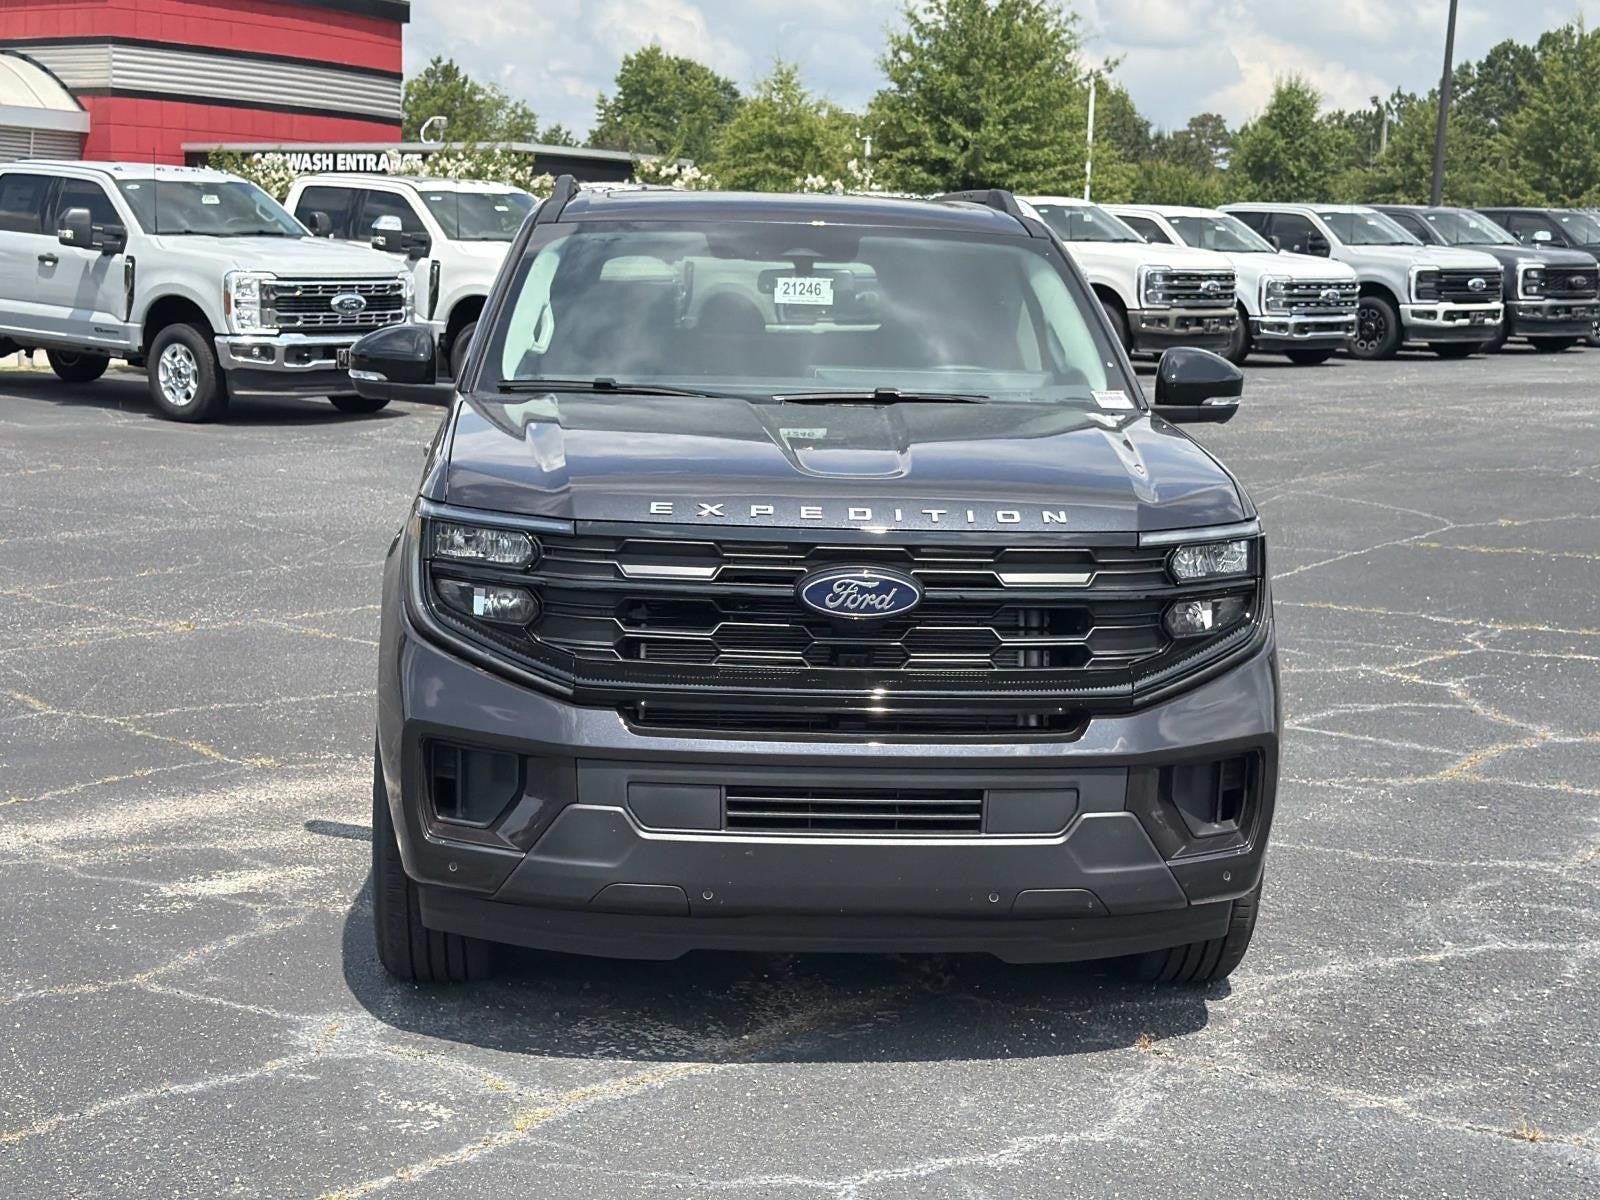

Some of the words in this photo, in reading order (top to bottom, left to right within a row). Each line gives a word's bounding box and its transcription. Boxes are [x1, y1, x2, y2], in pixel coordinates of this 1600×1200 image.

[285, 153, 334, 171] WASH
[782, 281, 822, 296] 21246
[649, 501, 1068, 525] EXPEDITION
[825, 578, 896, 611] Ford
